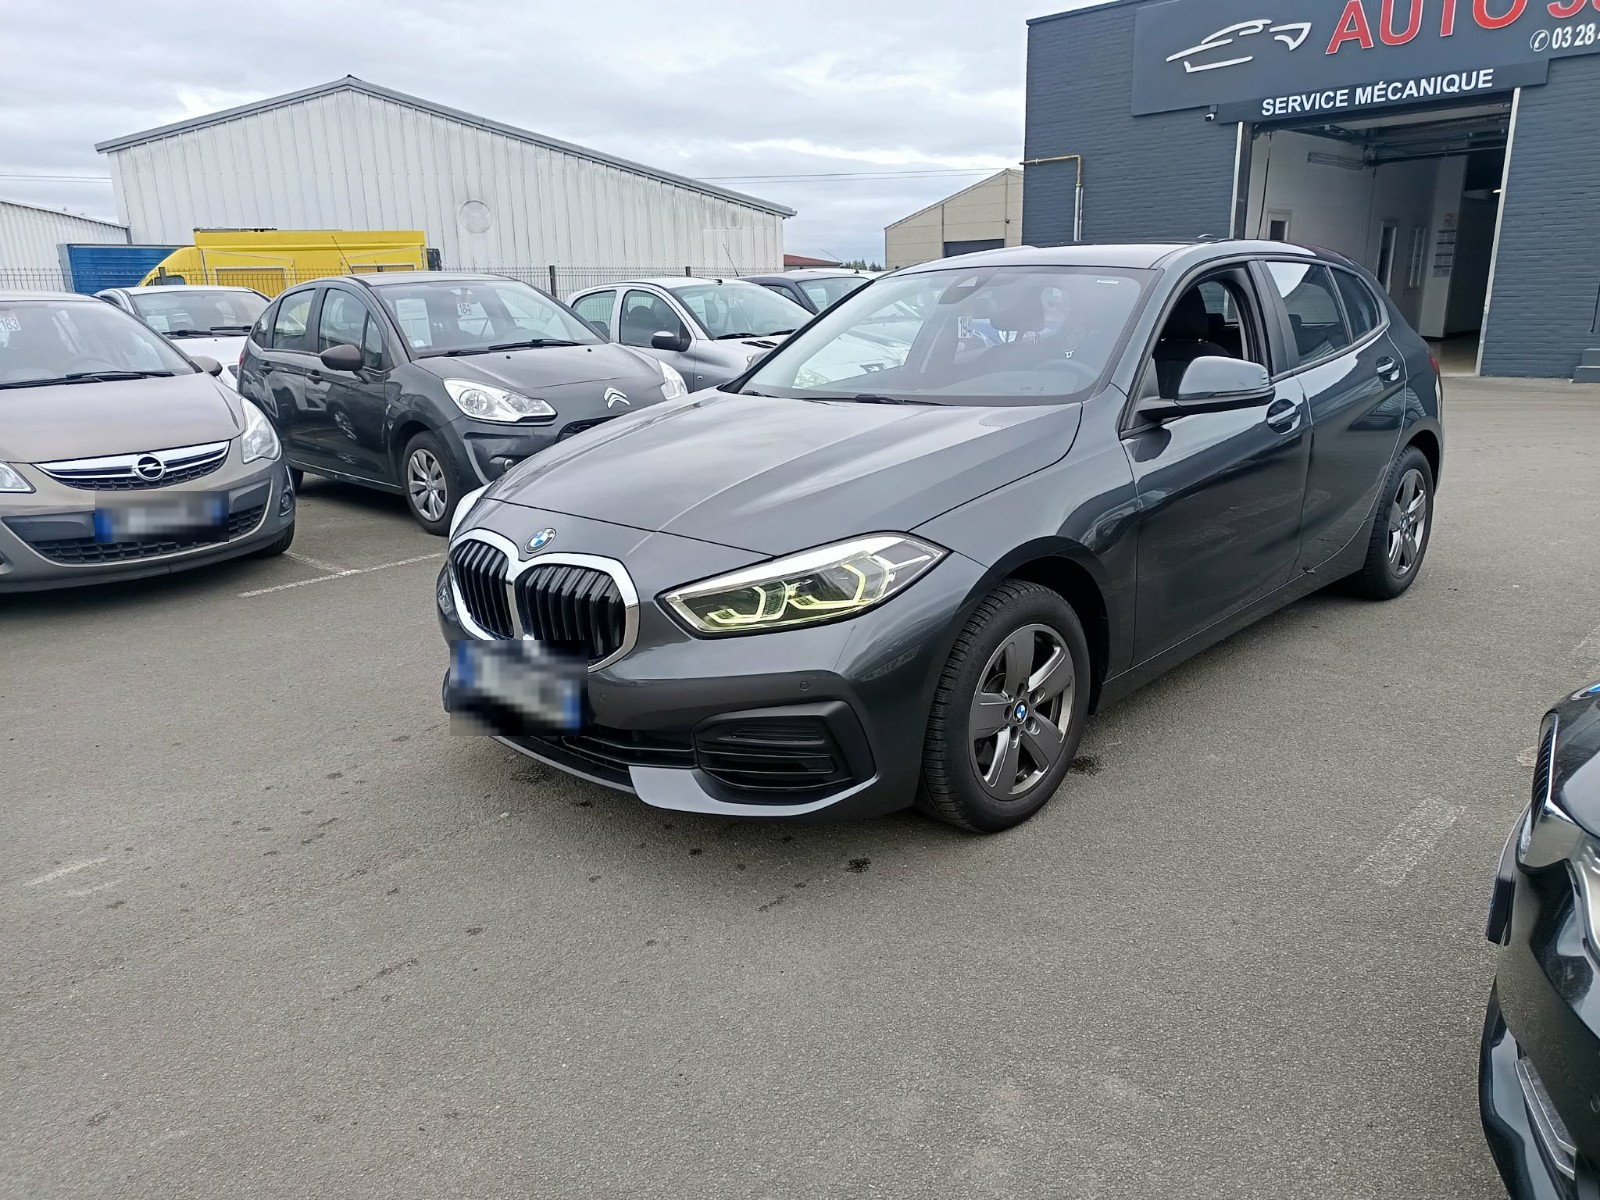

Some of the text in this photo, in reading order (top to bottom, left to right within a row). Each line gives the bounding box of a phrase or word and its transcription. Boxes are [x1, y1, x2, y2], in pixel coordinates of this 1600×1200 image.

[1325, 0, 1528, 55] AUTO
[1552, 27, 1572, 49] 03
[1574, 22, 1596, 46] 28
[1261, 68, 1494, 116] SERVICE MÉCANIQUE
